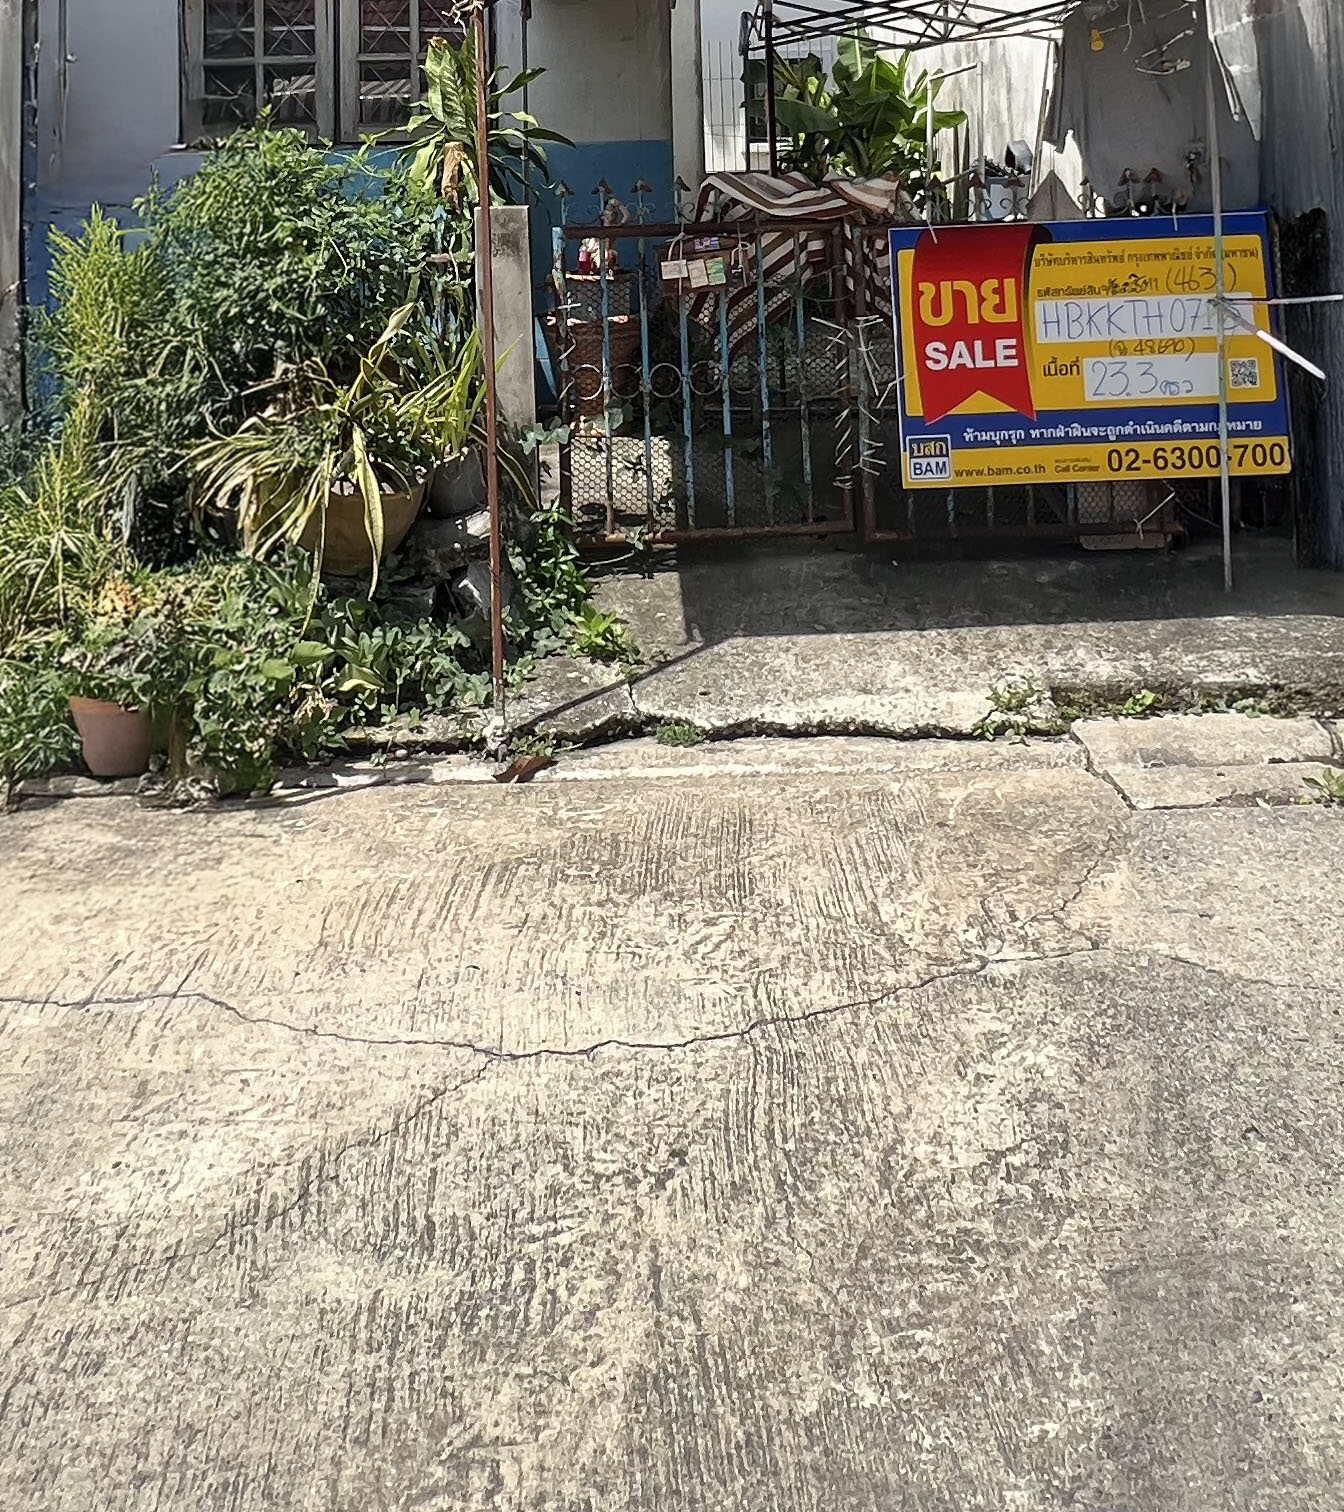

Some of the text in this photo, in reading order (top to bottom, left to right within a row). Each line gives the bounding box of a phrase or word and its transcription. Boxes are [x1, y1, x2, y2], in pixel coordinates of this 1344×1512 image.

[918, 277, 1019, 327] ขาย
[924, 337, 1019, 371] SALE
[1042, 355, 1081, 377] เนื้อที่
[1091, 359, 1158, 397] 23.3
[962, 426, 1025, 445] ห้ามบุกรุก
[911, 439, 947, 457] บสก
[1106, 442, 1285, 473] 02-6300-700
[912, 460, 948, 476] BAM
[953, 464, 1046, 478] www.bam.co.th
